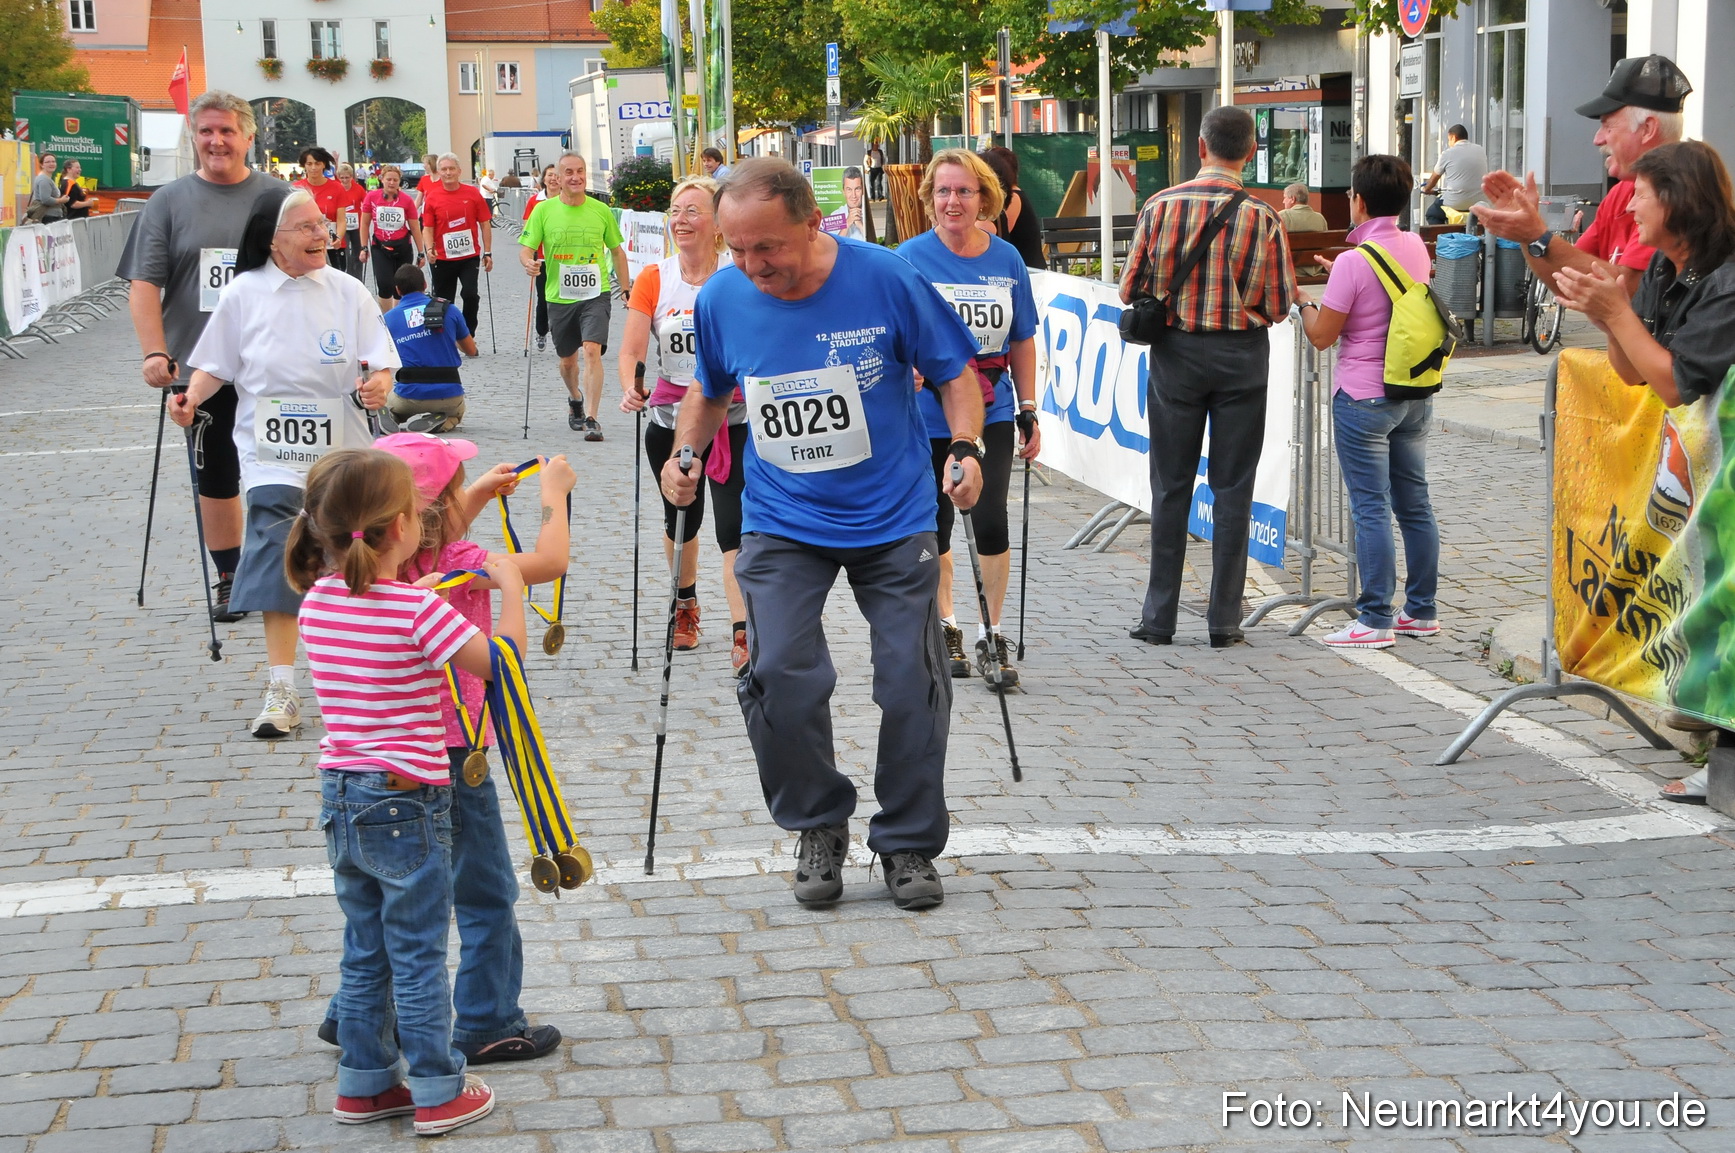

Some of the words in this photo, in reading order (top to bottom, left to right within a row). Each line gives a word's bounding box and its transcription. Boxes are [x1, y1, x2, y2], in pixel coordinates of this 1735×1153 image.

[828, 47, 836, 73] P
[51, 134, 95, 144] Neumarkter
[804, 161, 811, 171] P
[379, 212, 401, 222] 8052
[447, 236, 470, 249] 8045
[564, 273, 597, 287] 8096
[953, 289, 986, 298] BOCK
[396, 329, 432, 345] neumarkt
[815, 333, 830, 342] 12.
[830, 326, 887, 341] NEUMARKTER
[829, 335, 877, 349] STADTLAUF
[771, 377, 818, 394] BOCK
[280, 403, 318, 412] BOCK
[760, 394, 851, 439] 8029
[266, 418, 332, 446] 8031
[275, 449, 324, 463] Johann
[790, 444, 834, 462] Franz
